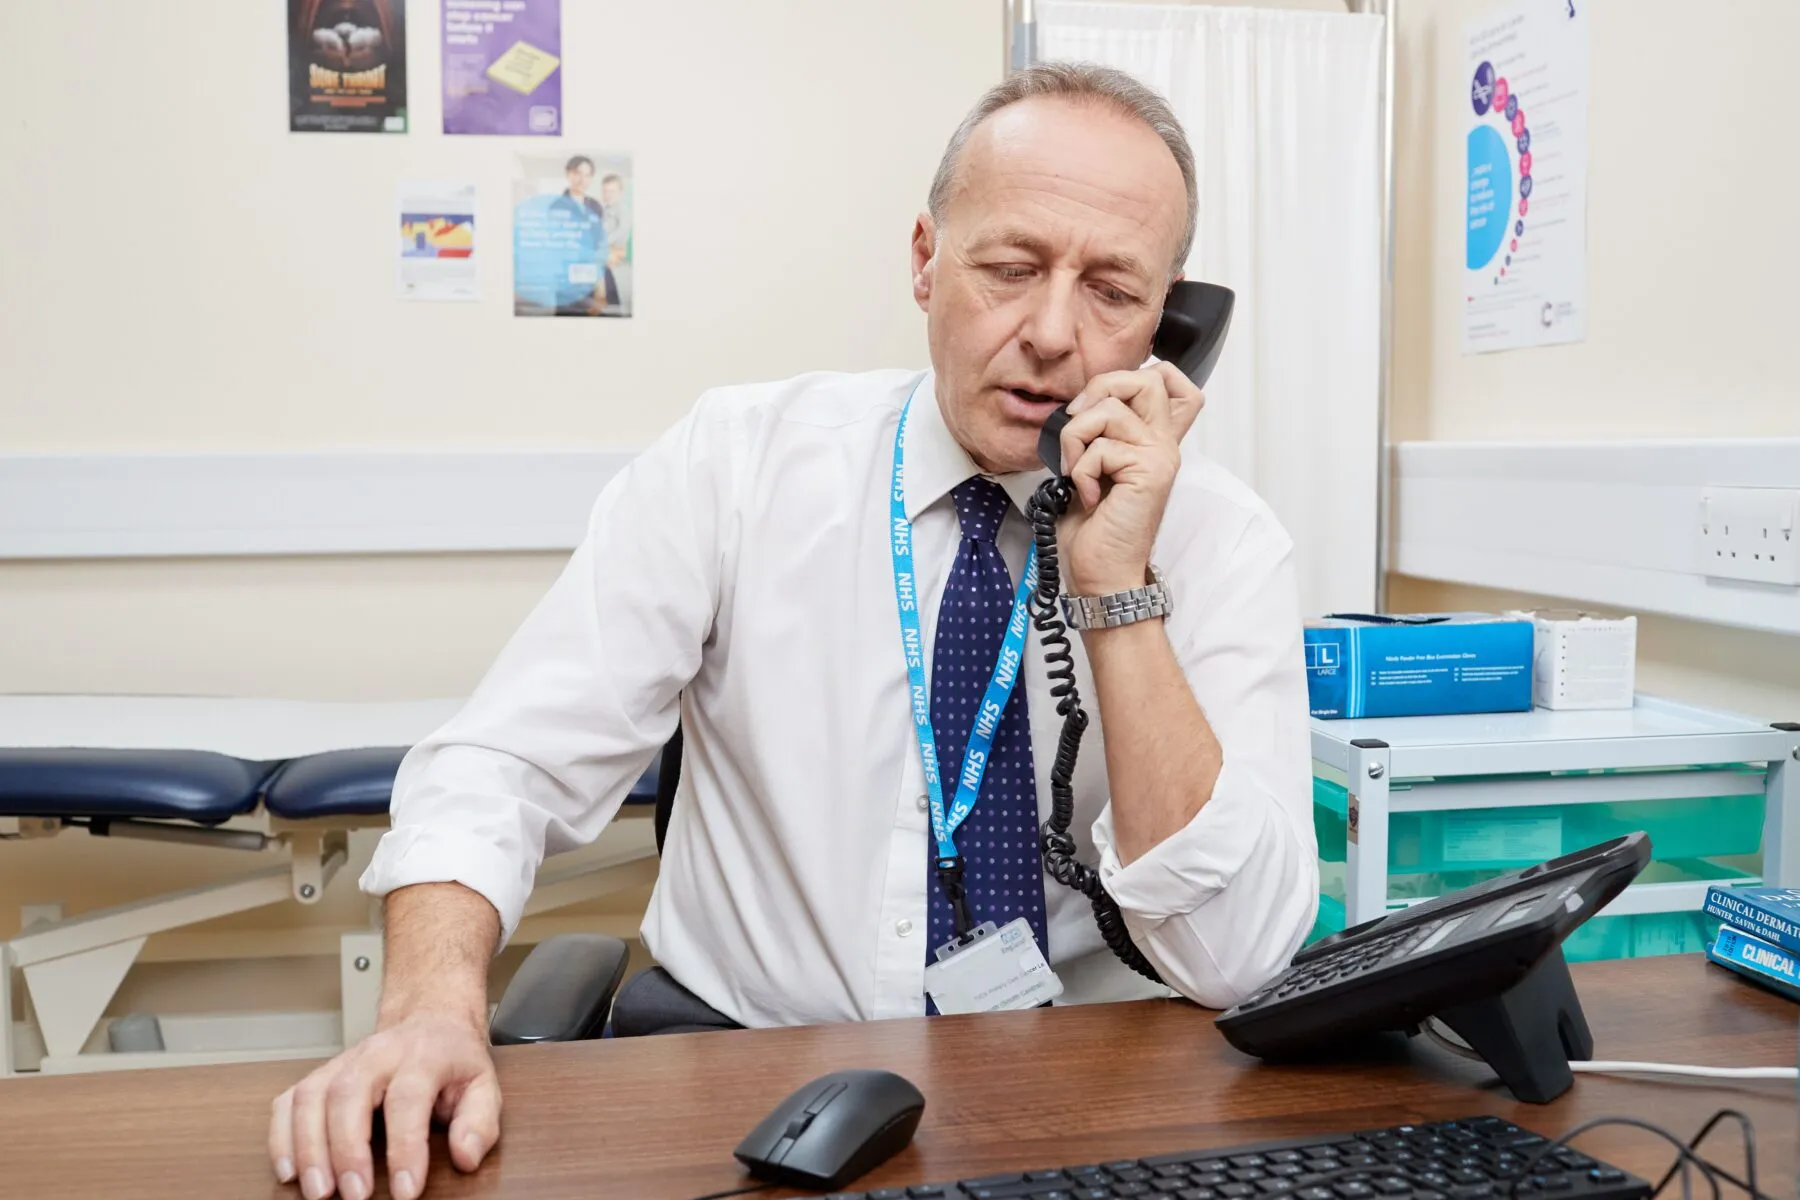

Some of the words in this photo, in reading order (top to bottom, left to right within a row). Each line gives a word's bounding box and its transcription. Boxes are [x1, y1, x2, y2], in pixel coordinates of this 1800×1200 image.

[895, 518, 909, 555] NHS
[898, 572, 915, 611] NHS
[1010, 600, 1028, 639] NHS
[904, 628, 921, 668] NHS
[995, 646, 1019, 689] NHS
[1322, 648, 1334, 663] L
[1317, 668, 1336, 676] LARGE
[913, 685, 928, 726] NHS
[975, 700, 1000, 739] NHS
[922, 743, 937, 785] NHS
[962, 749, 985, 791] NHS
[931, 801, 947, 843] NHS
[1707, 905, 1734, 922] HUNTER,
[1734, 916, 1755, 931] SAVIN
[1761, 928, 1781, 942] DAHL
[1711, 892, 1755, 919] CLINICAL
[1742, 943, 1795, 977] CLINICAL
